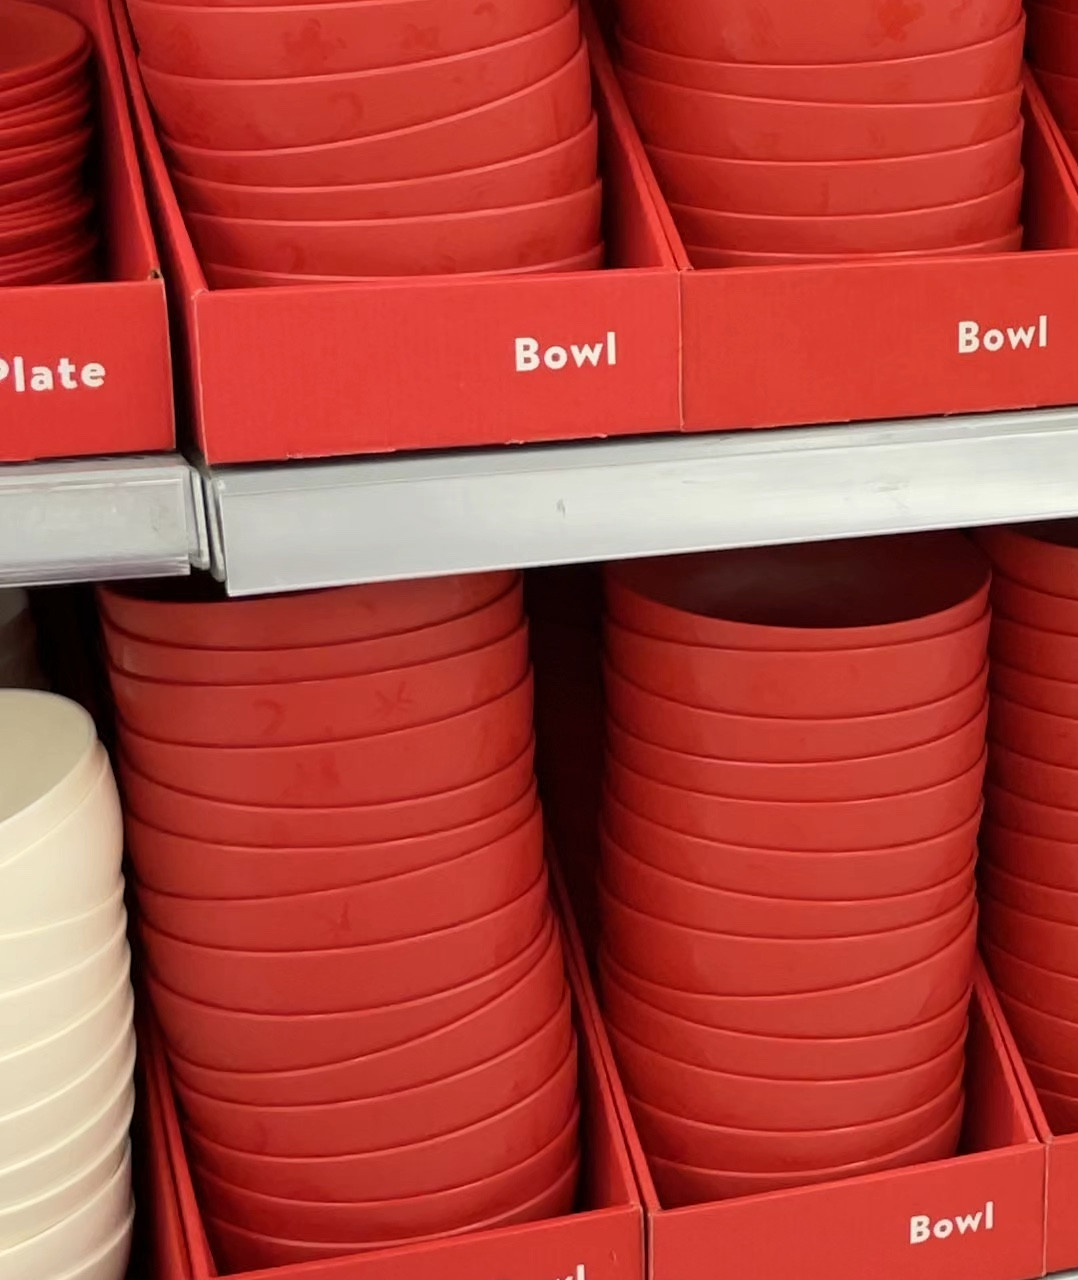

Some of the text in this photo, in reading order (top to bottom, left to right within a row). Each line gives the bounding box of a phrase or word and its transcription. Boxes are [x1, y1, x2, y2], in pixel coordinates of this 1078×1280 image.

[515, 331, 617, 372] Bowl
[958, 315, 1047, 354] Bowl
[909, 1201, 994, 1244] Bowl
